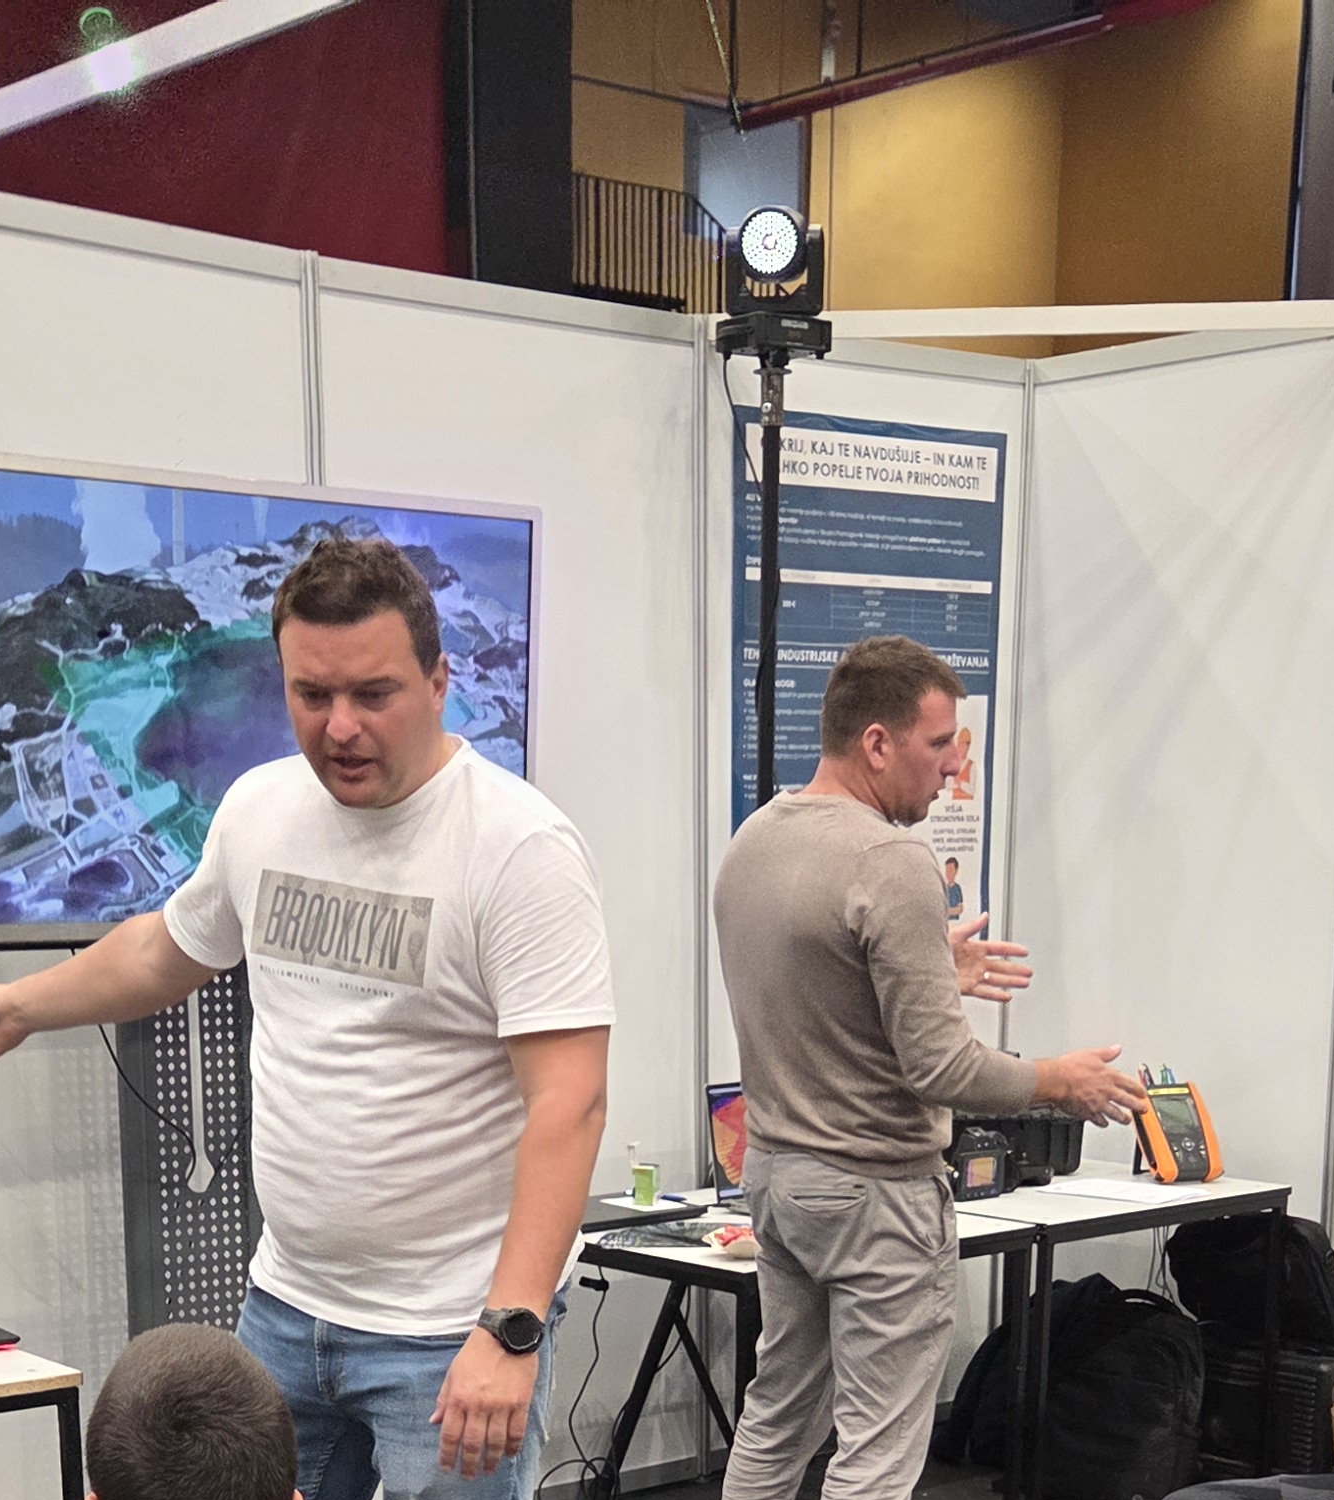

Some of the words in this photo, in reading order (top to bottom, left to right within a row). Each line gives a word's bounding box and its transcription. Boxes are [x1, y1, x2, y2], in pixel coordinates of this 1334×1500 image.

[811, 440, 834, 457] KAJ
[838, 443, 850, 457] TE
[853, 445, 921, 465] NAVDUŠUJE
[933, 454, 945, 466] IN
[948, 455, 974, 469] KAM
[976, 456, 987, 470] TE
[813, 461, 862, 480] POPELJE
[865, 465, 903, 484] TVOJA
[907, 469, 980, 490] PRIHODNOST!
[777, 649, 838, 662] INDUSTRIJSKE
[263, 885, 408, 970] BROOKLYN
